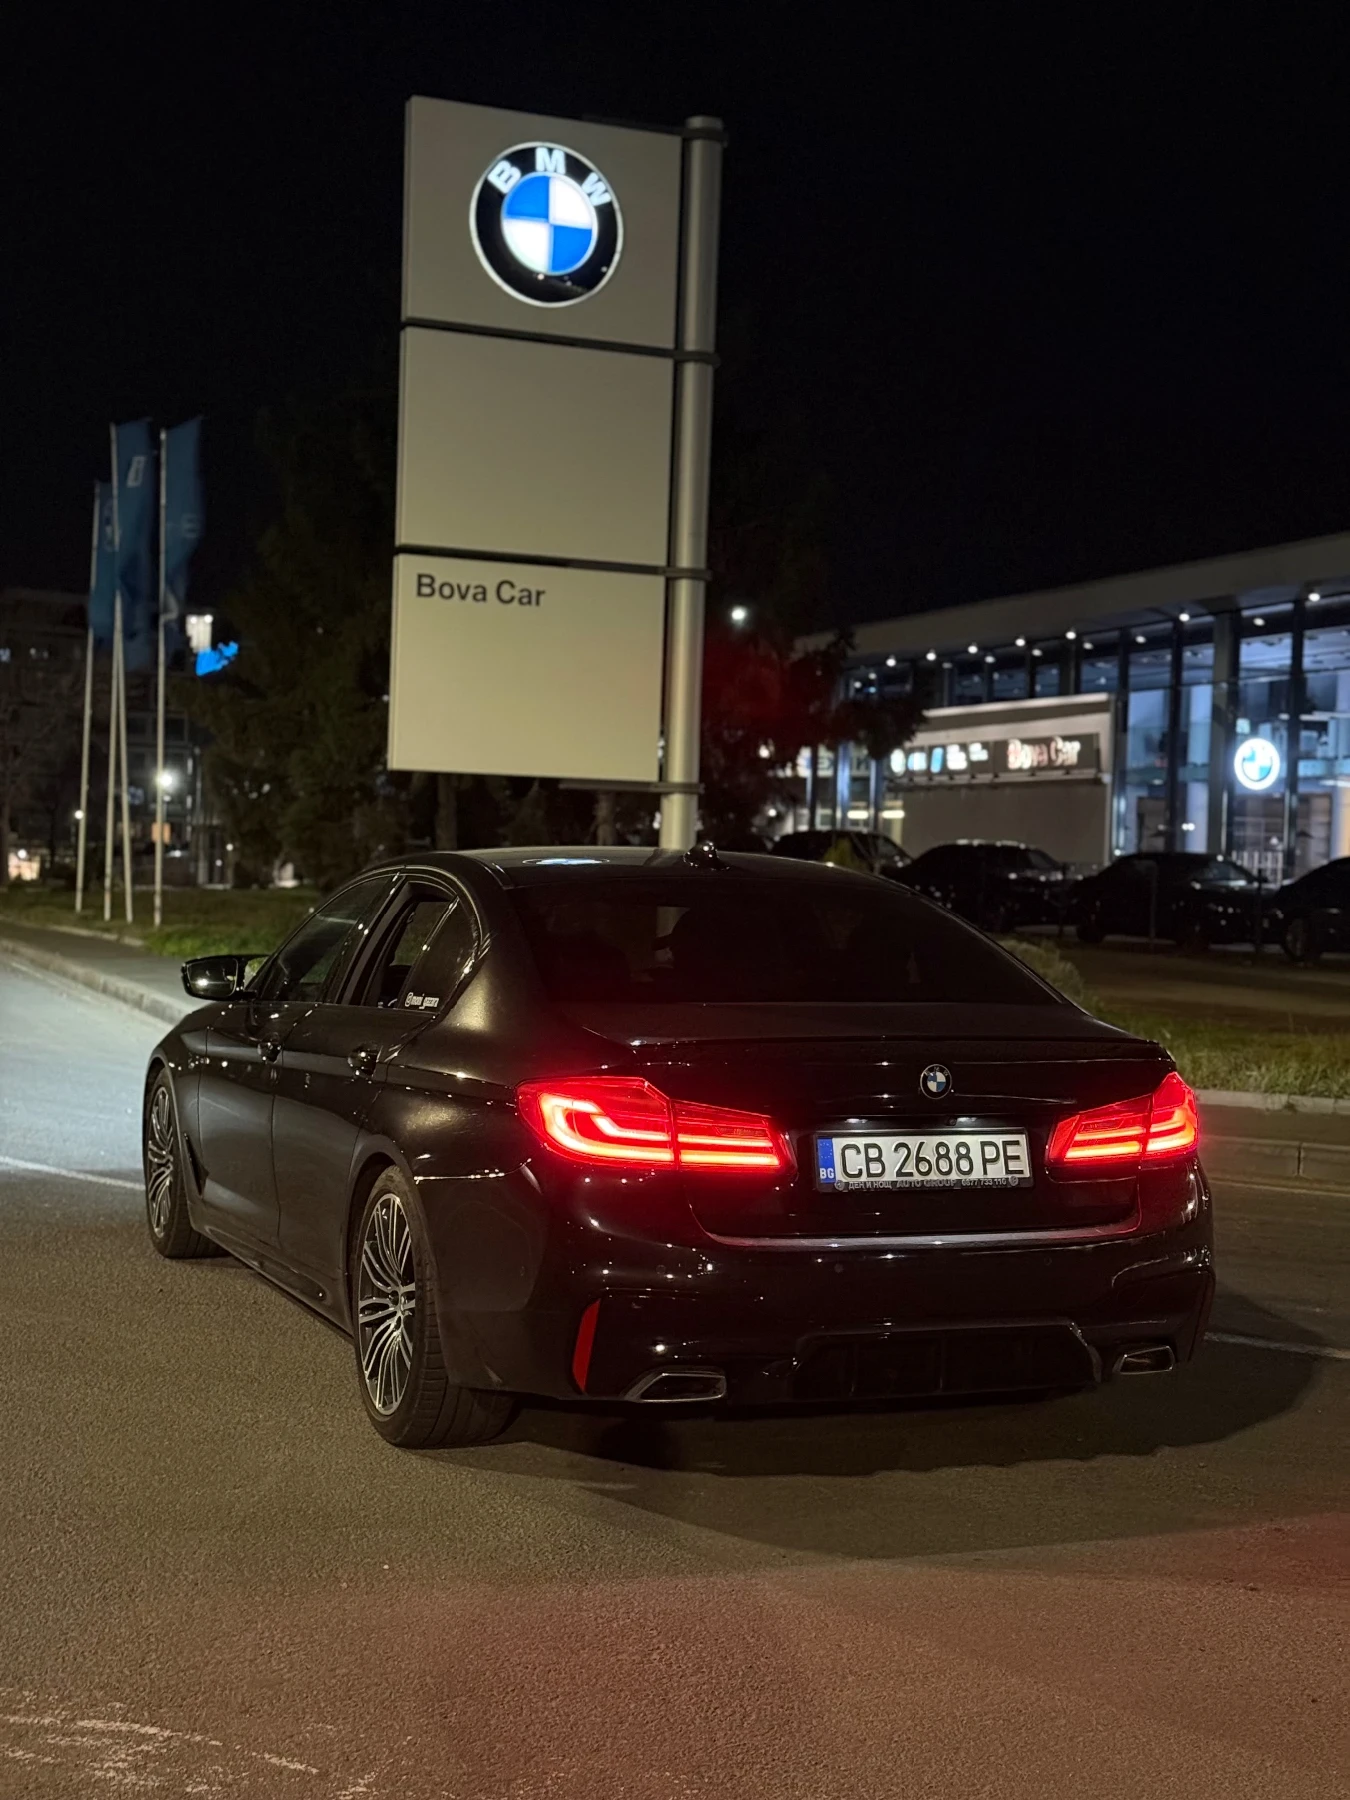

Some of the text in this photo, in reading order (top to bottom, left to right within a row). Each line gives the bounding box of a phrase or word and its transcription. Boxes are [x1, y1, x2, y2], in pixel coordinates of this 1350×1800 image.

[487, 146, 612, 207] BMW
[416, 573, 546, 607] Bova Car
[840, 1139, 1025, 1180] CB 2688 PE
[819, 1167, 835, 1179] BG
[896, 1179, 921, 1188] AUTO
[848, 1181, 864, 1190] ДЕН
